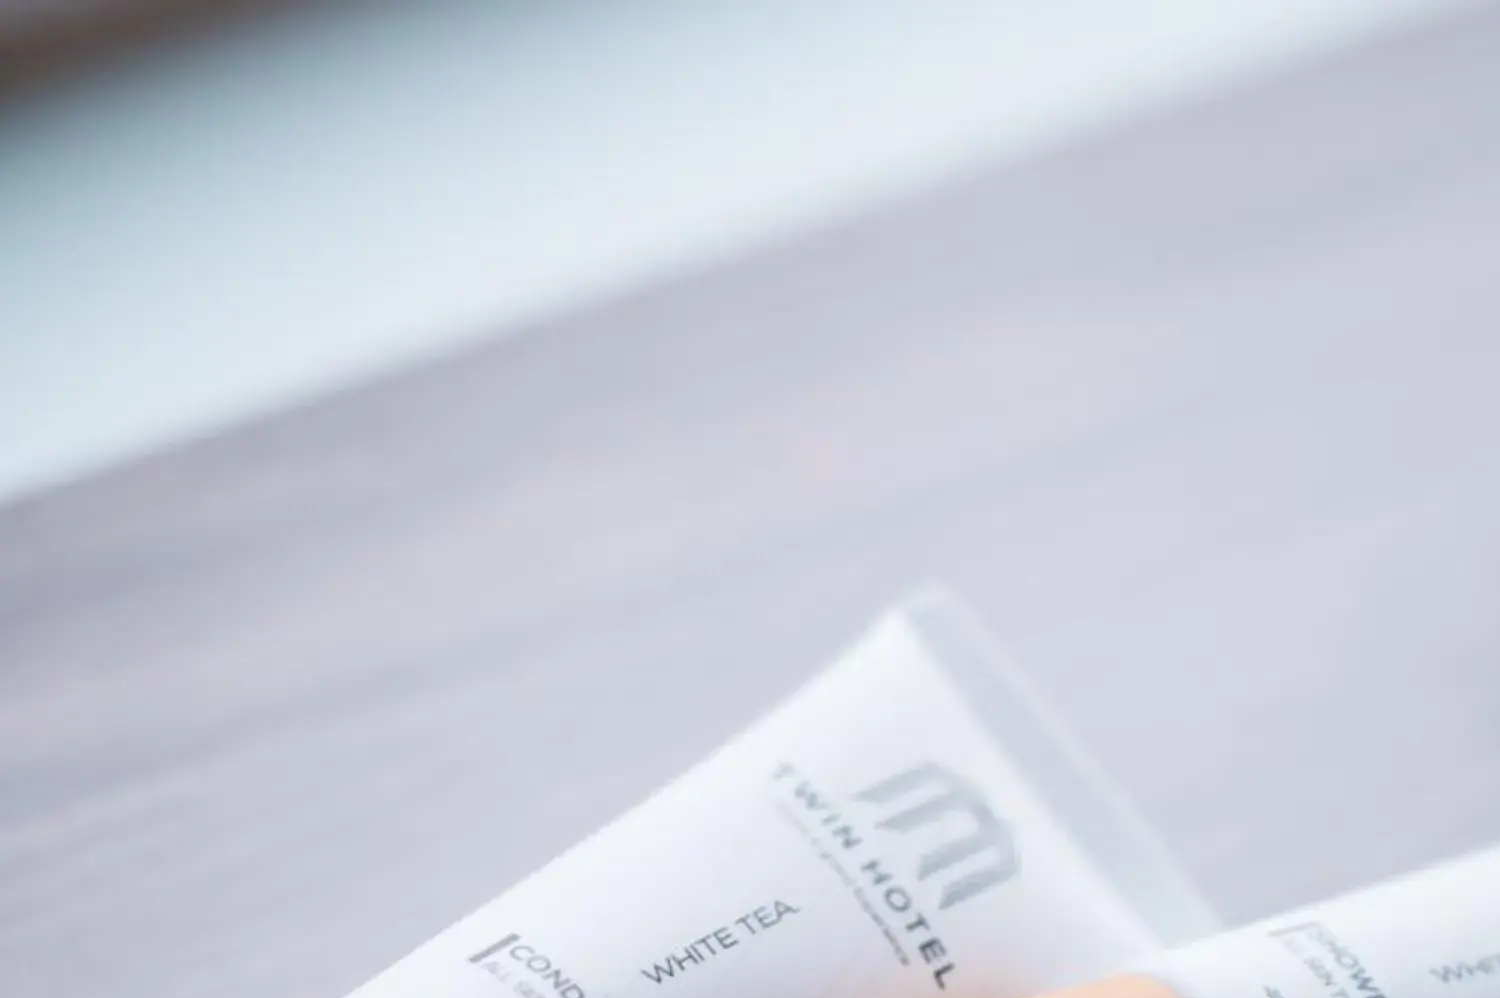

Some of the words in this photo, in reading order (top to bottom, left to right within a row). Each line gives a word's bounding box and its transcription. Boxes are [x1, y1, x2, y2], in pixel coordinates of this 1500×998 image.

[640, 926, 740, 984] WHITE
[734, 900, 801, 936] TEA
[772, 762, 864, 849] TWIN
[860, 859, 955, 991] HOTEL
